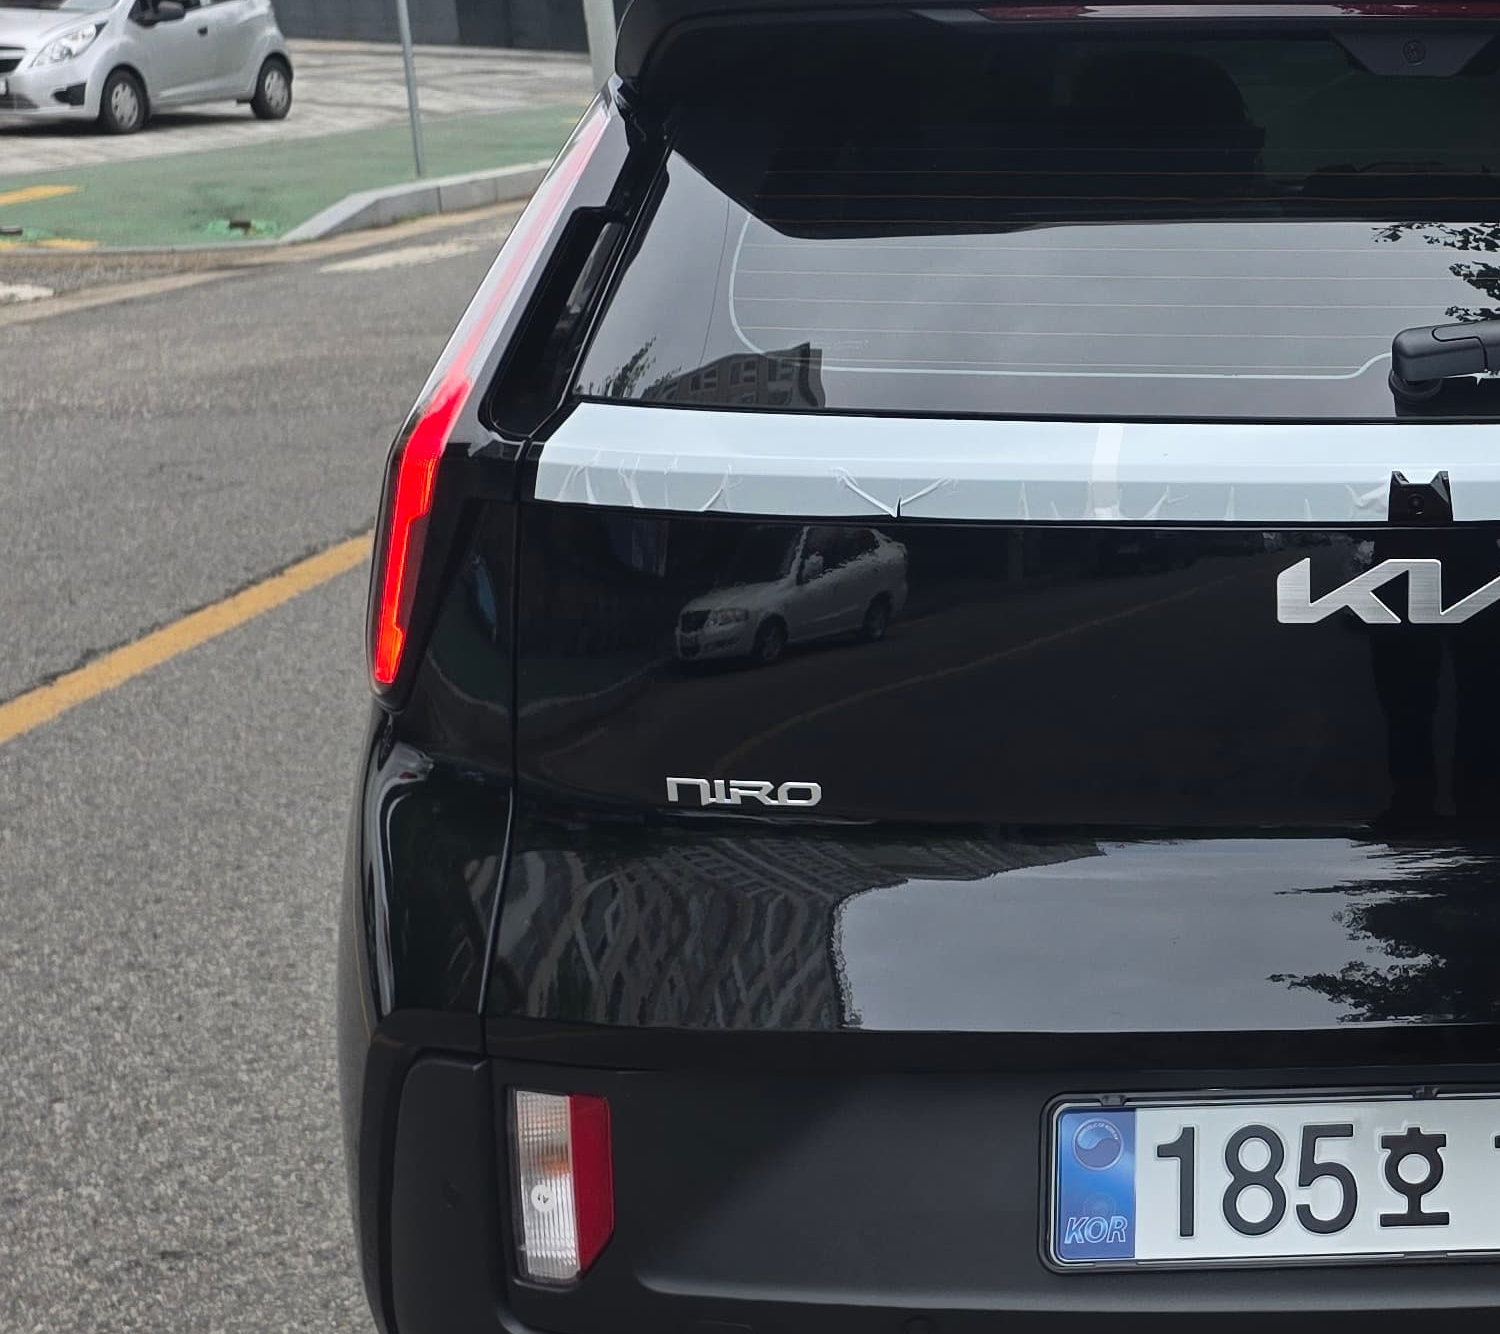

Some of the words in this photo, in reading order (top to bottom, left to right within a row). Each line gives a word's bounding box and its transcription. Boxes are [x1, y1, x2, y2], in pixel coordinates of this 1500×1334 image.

[666, 777, 822, 807] NIRO
[1156, 1123, 1451, 1239] 185호
[1064, 1215, 1128, 1244] KOR
